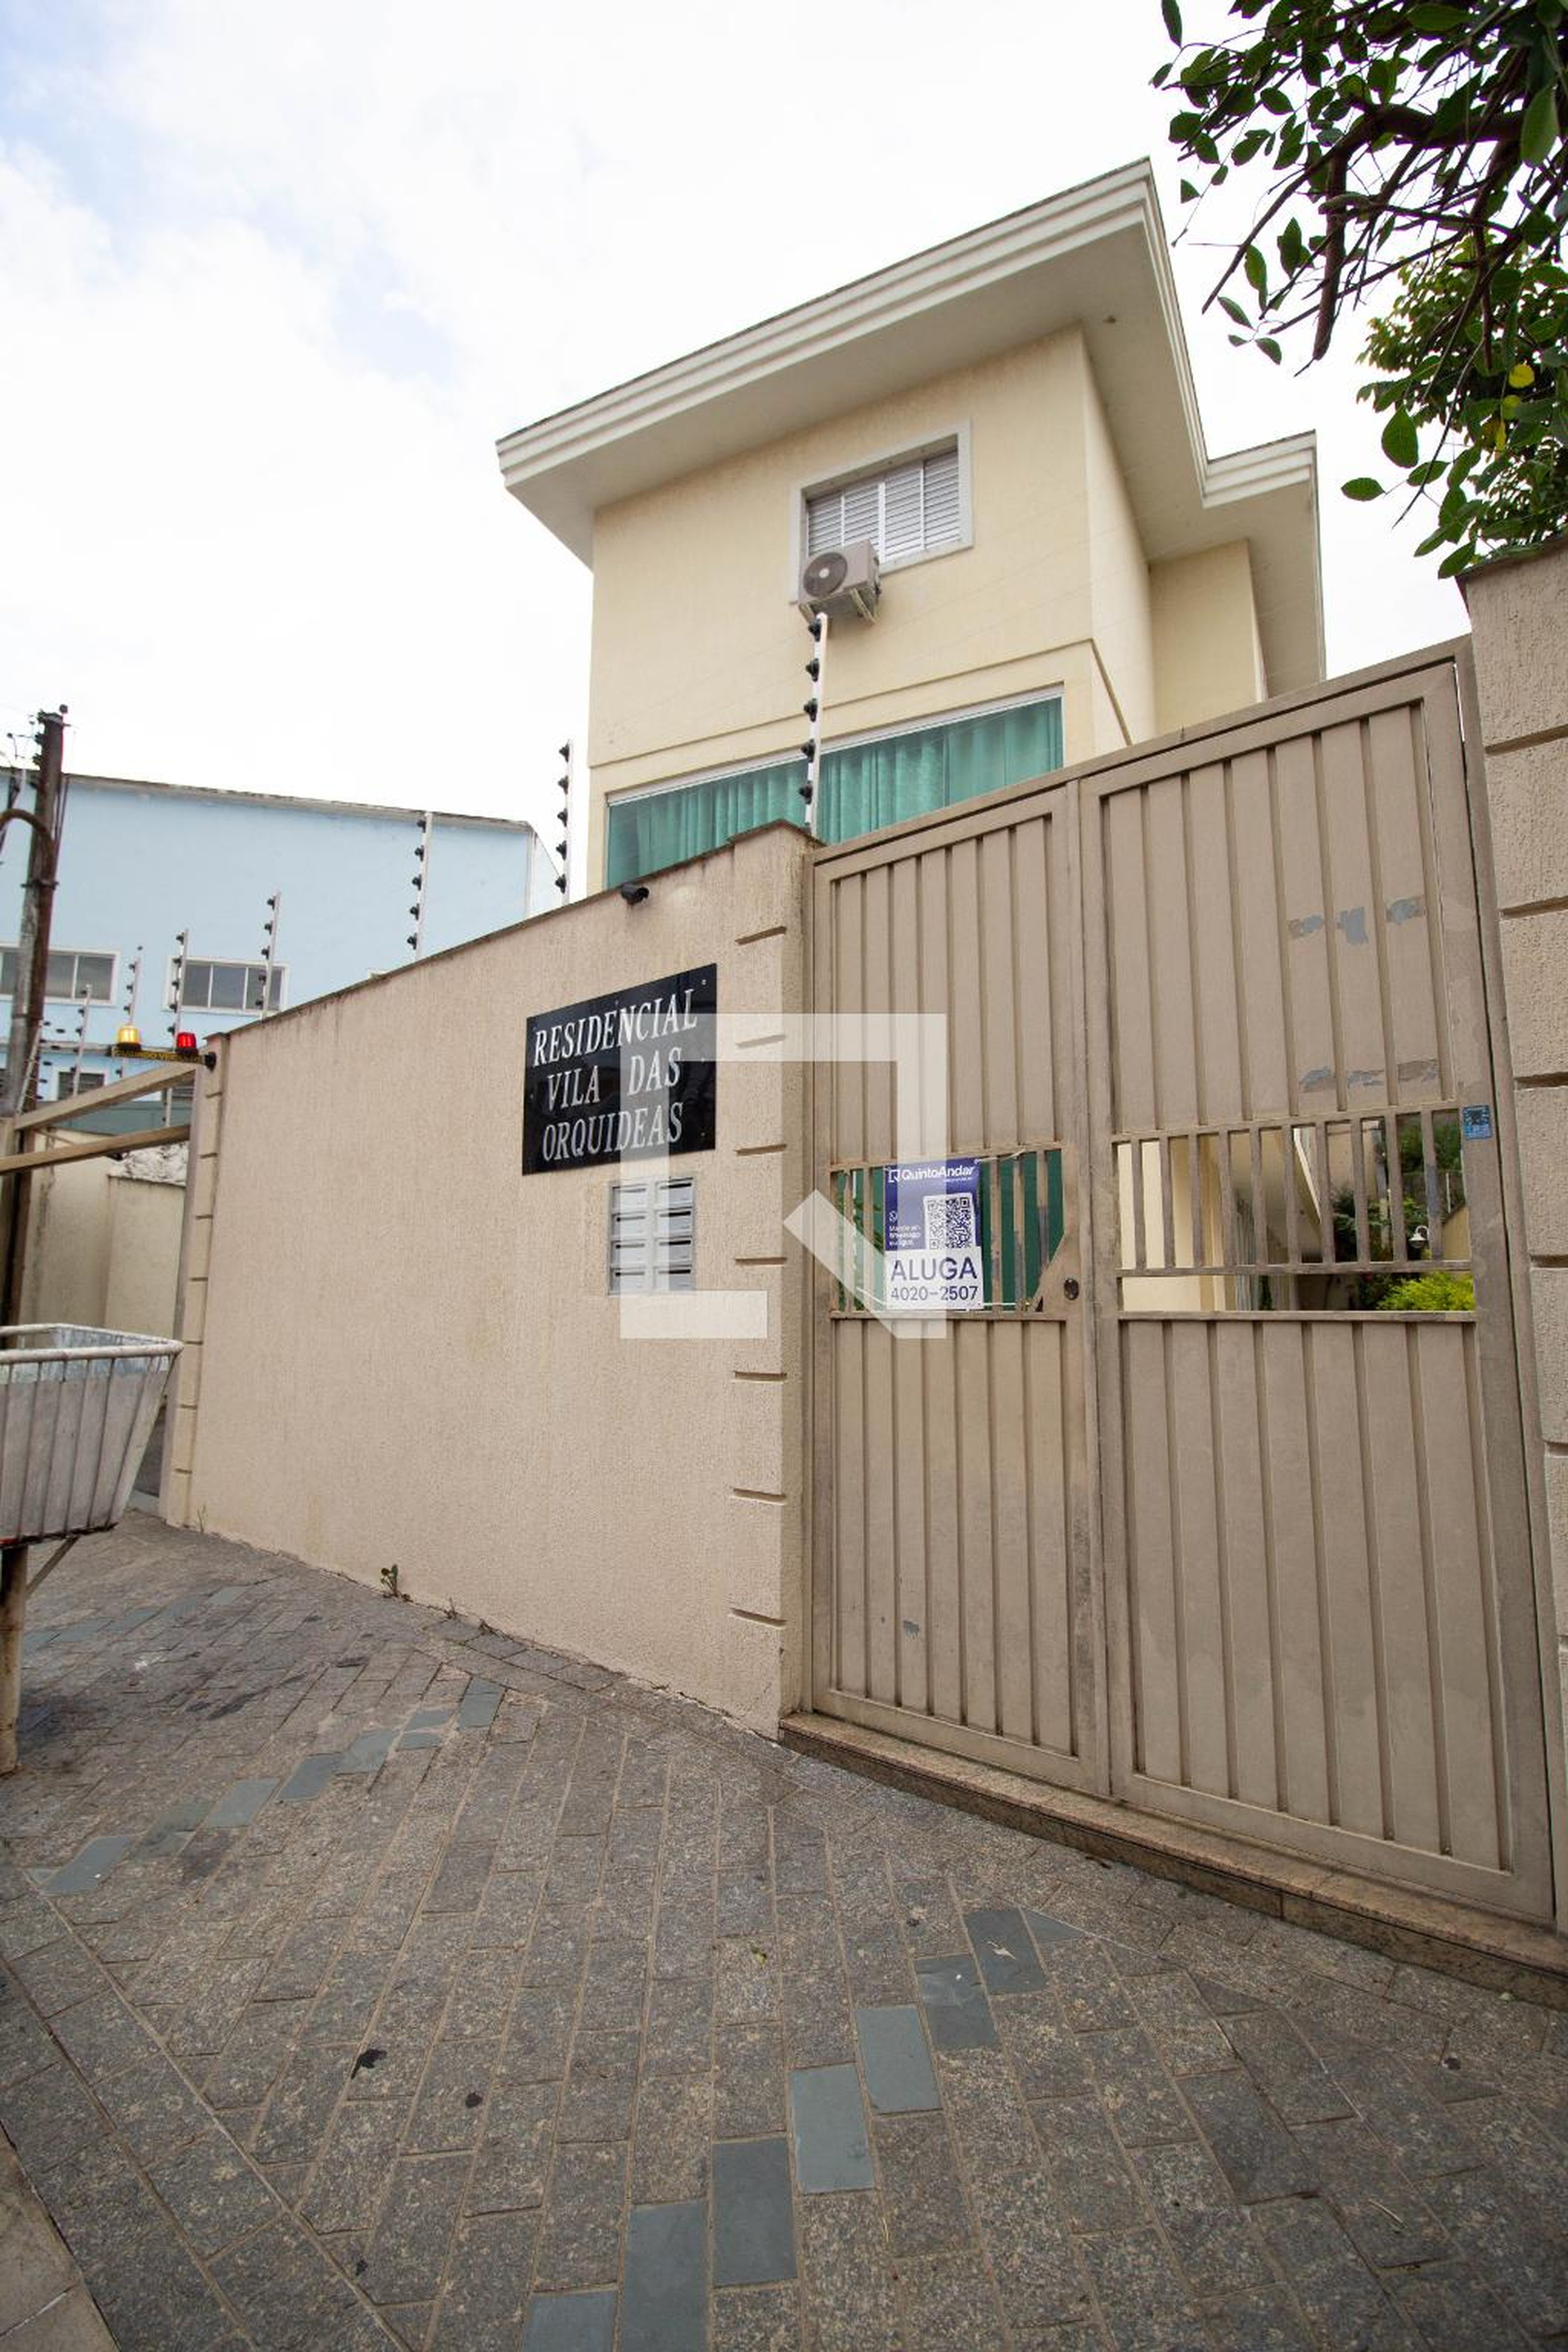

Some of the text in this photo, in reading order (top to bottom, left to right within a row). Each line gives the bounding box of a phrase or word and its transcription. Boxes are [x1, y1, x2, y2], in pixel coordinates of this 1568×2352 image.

[533, 989, 697, 1067] RESIDENCIAL
[547, 1047, 682, 1111] VILA DAS
[542, 1102, 683, 1161] ORQUIDEAS
[902, 1165, 975, 1180] QuintoAndar
[891, 1256, 978, 1281] ALUGA
[891, 1285, 978, 1300] 4020-2507
